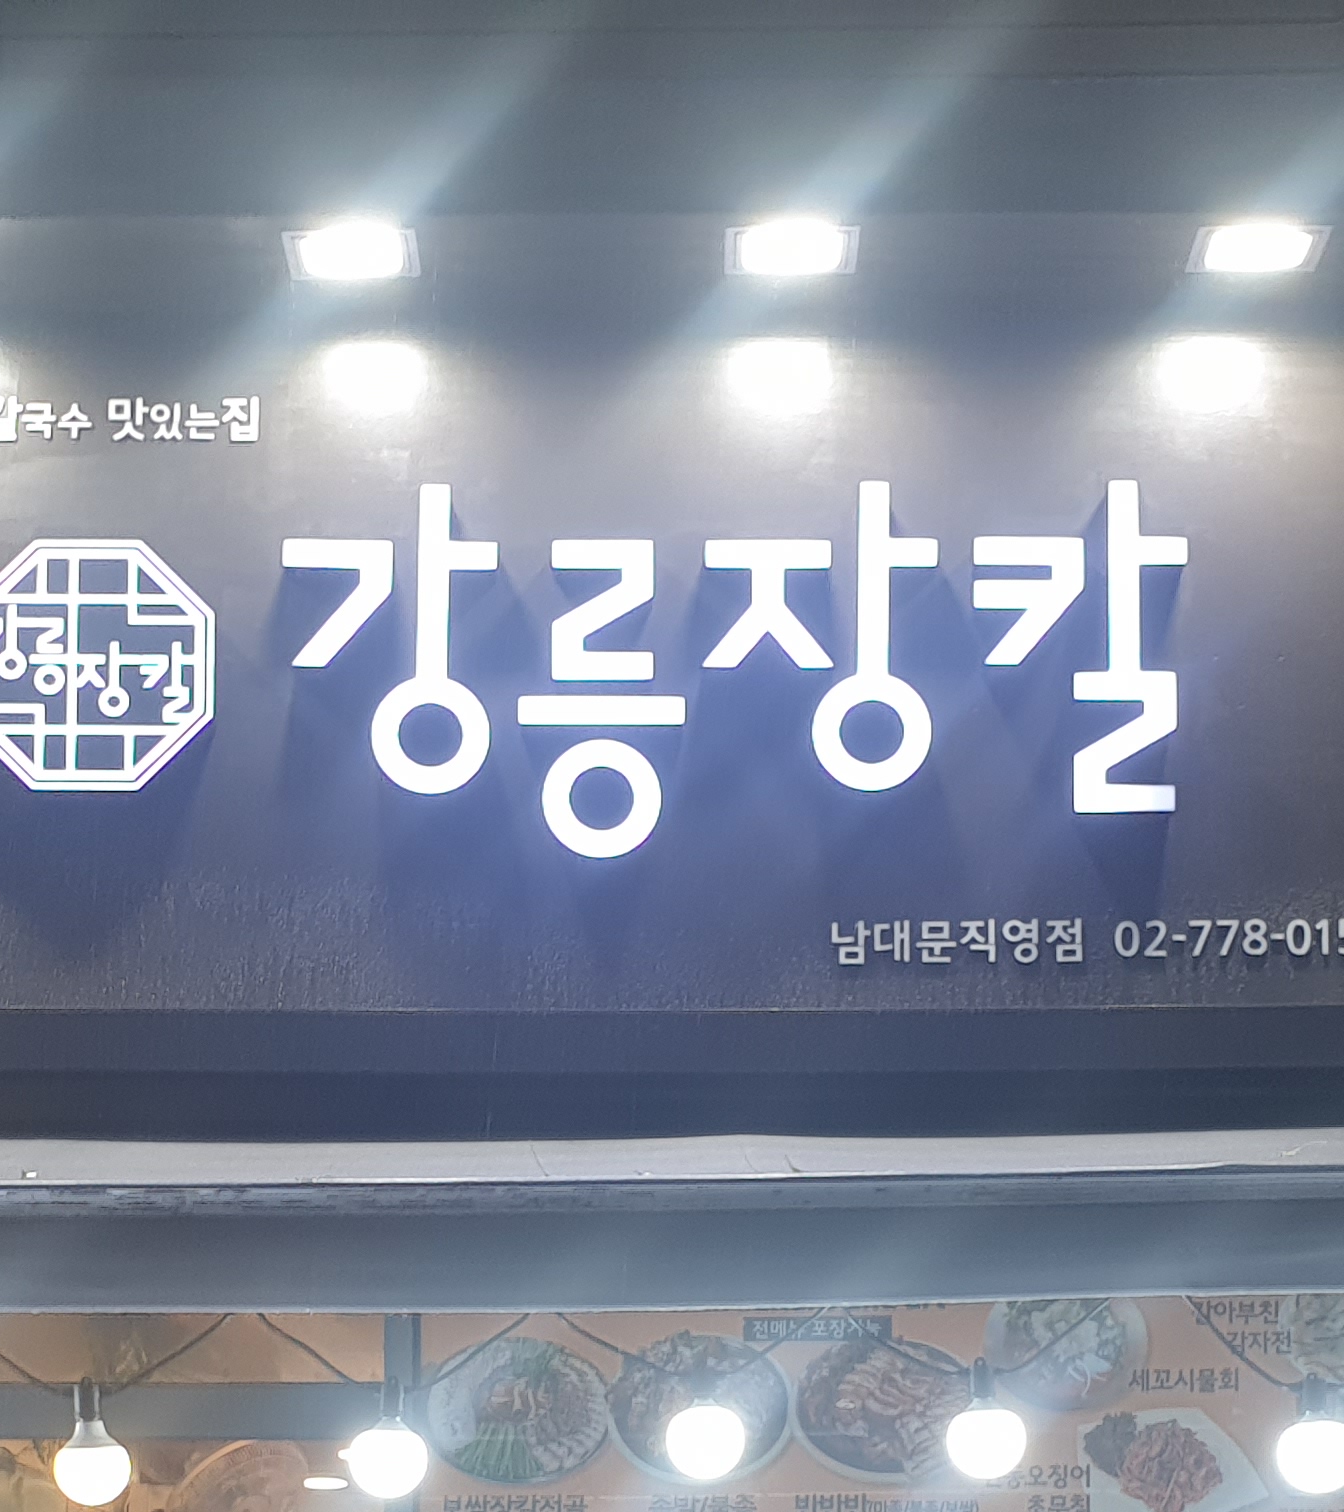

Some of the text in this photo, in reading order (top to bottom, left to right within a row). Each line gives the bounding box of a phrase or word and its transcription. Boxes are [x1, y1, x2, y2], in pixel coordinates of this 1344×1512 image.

[106, 395, 261, 443] 맛있는집
[281, 483, 1189, 860] 강릉장칼
[830, 917, 1086, 966] 남대문직영점
